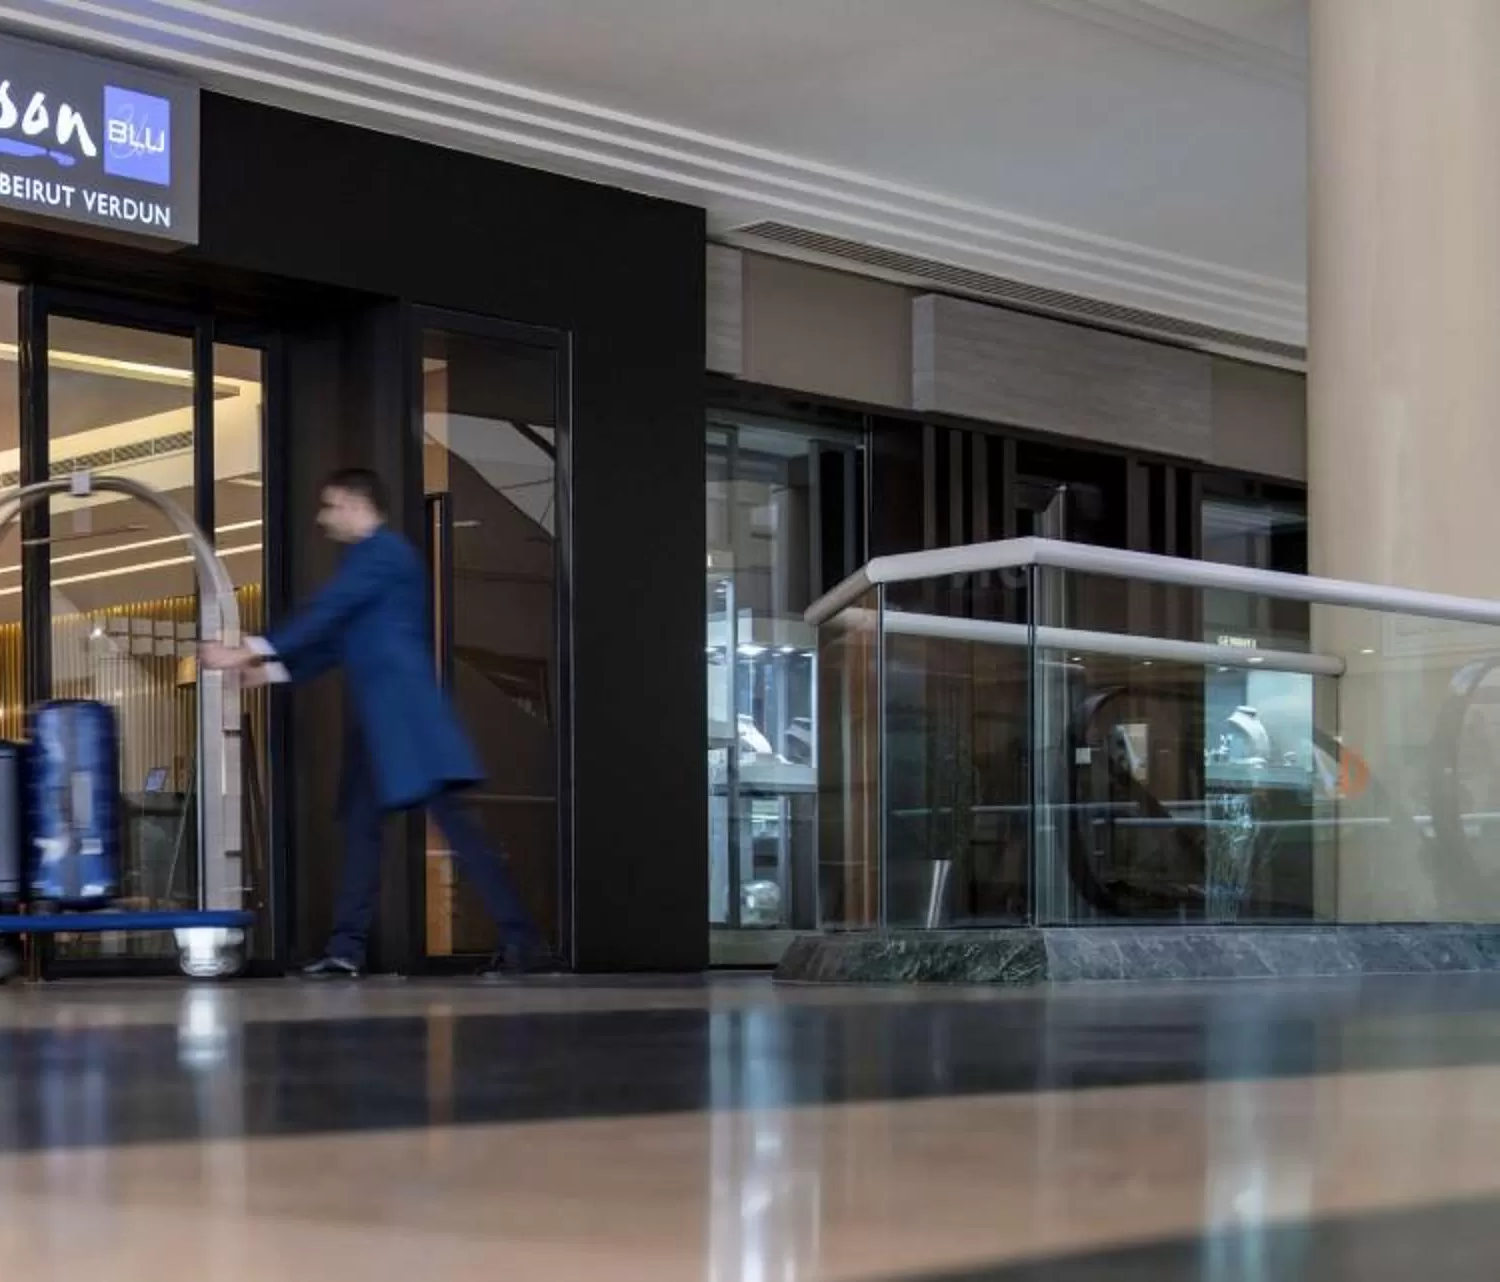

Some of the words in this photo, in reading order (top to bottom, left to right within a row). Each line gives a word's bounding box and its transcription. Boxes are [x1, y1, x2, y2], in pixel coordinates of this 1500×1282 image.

[108, 119, 165, 153] BLU
[0, 171, 75, 208] BEIRUT
[82, 188, 171, 228] VERDUN
